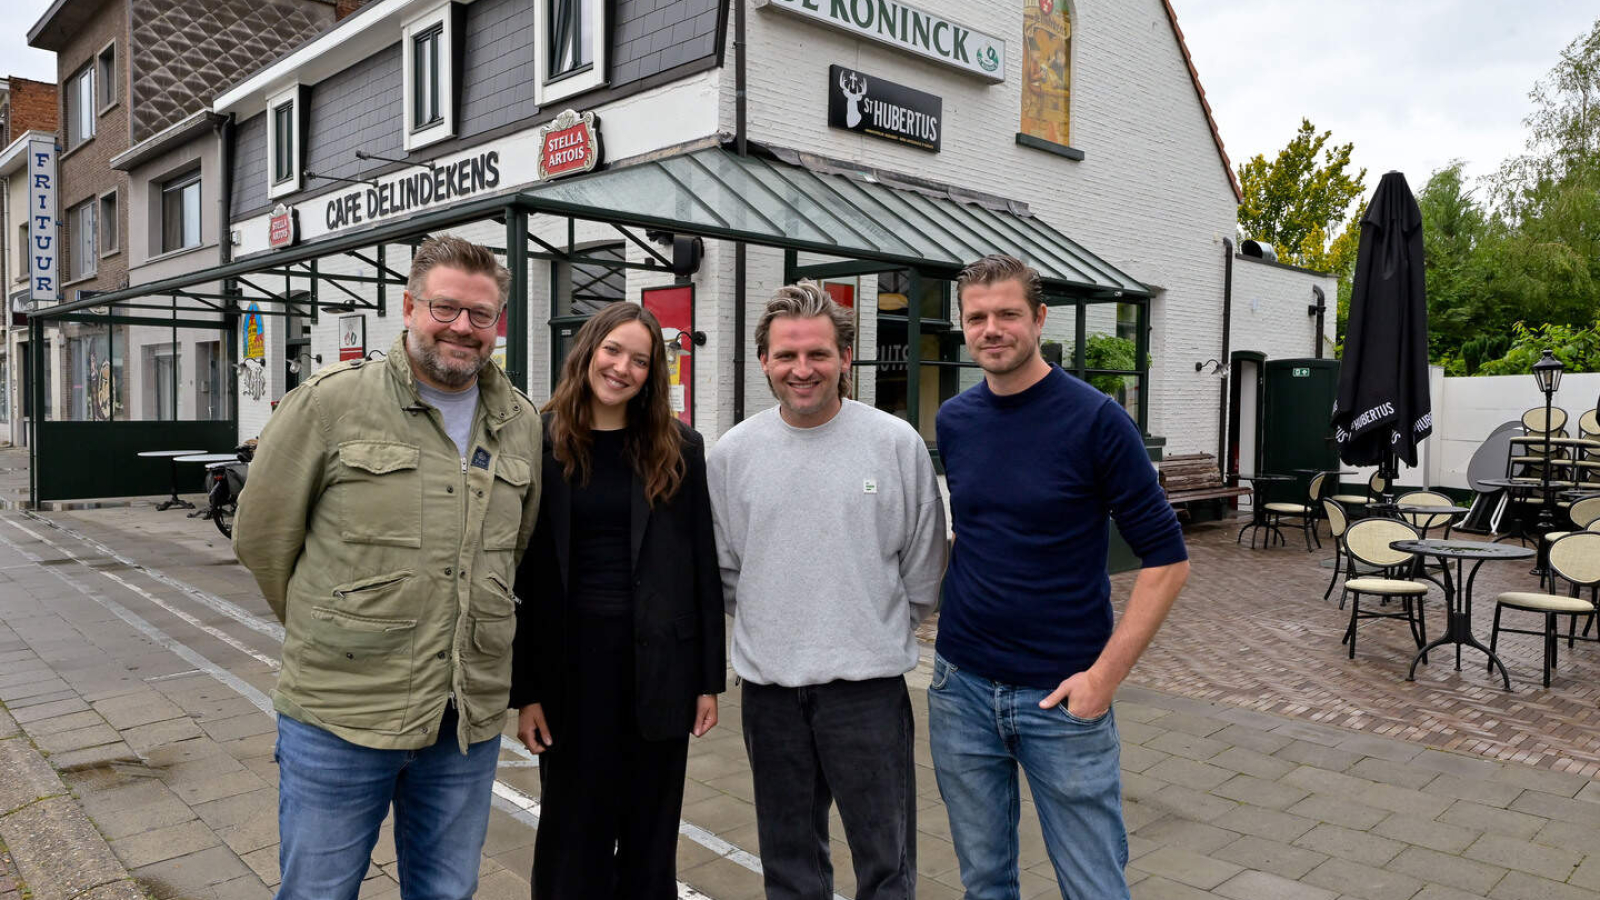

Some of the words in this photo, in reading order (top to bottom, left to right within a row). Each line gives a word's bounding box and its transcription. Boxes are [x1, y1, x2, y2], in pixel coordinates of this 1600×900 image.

[873, 100, 938, 141] HUBERTUS
[548, 131, 583, 152] STELLA
[549, 146, 585, 167] ARTOIS
[34, 153, 53, 291] FRITUUR
[326, 191, 362, 230] CAFE
[1353, 401, 1395, 431] HUBERTUS
